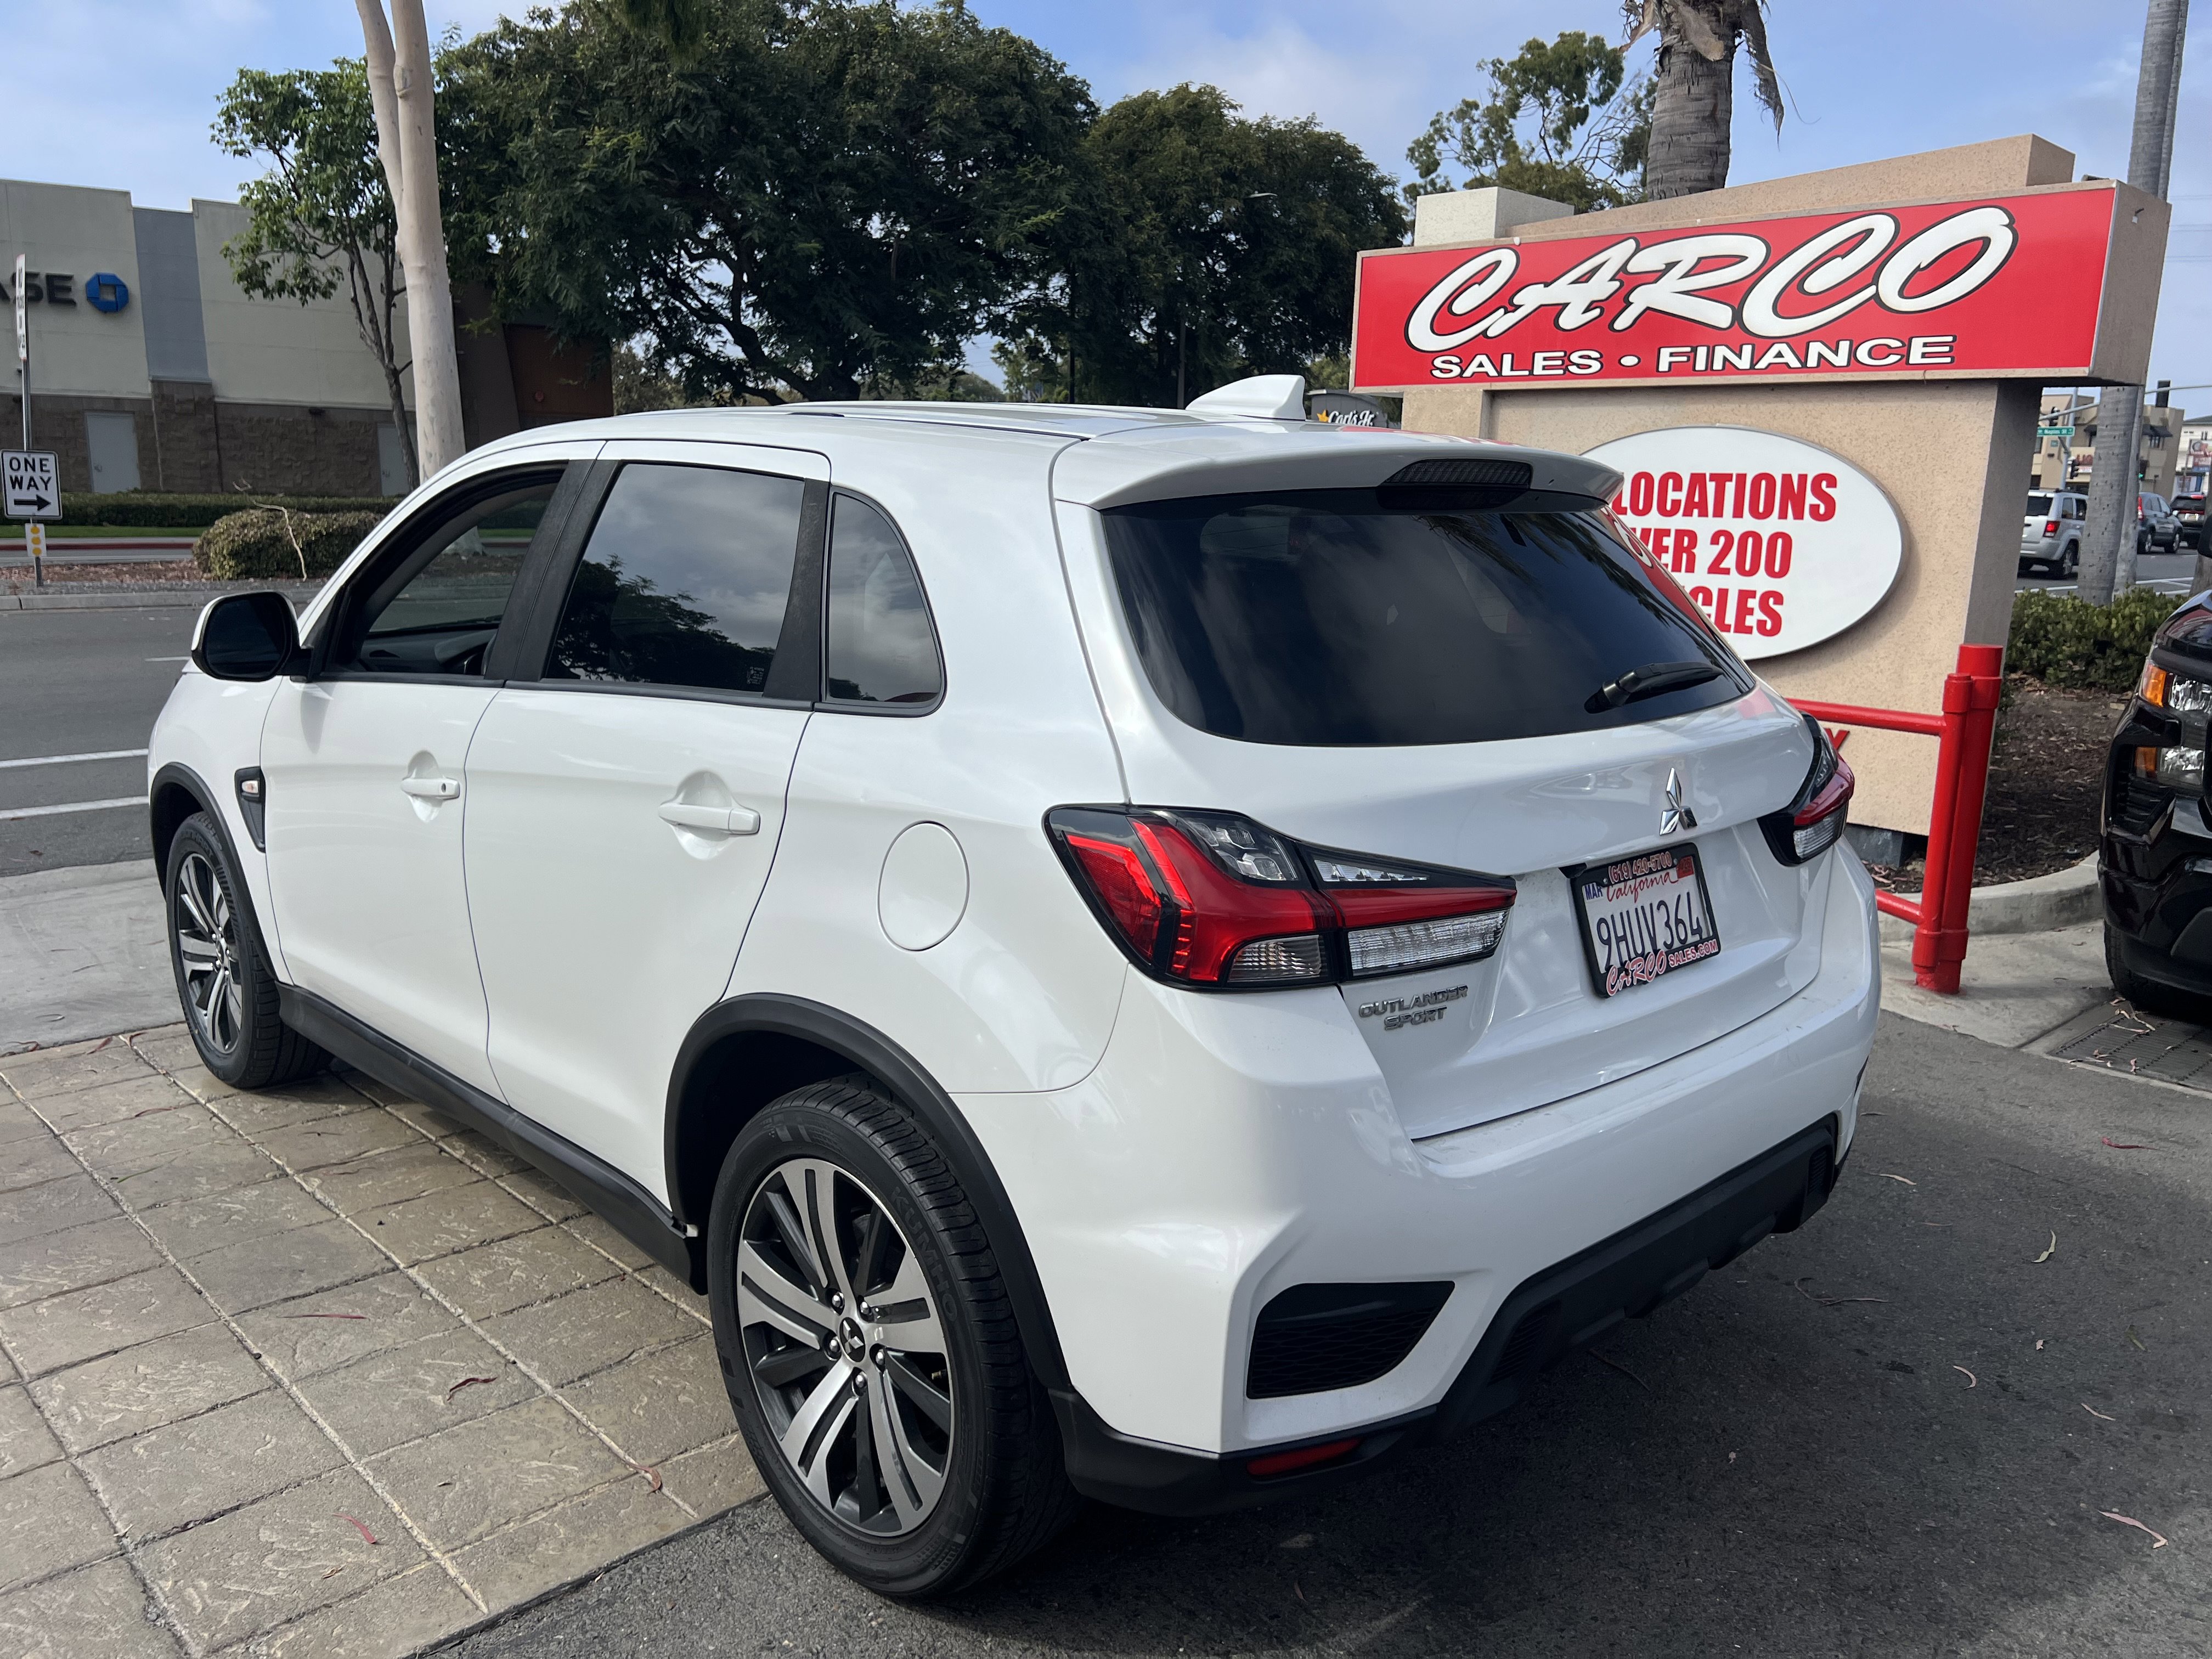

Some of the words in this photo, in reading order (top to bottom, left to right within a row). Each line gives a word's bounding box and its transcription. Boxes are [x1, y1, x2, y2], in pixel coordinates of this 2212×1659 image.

[1404, 206, 2019, 352] CARCO
[1431, 349, 1604, 379] SALES
[1656, 335, 1957, 372] FINANCE
[9, 456, 50, 472] ONE
[9, 475, 52, 491] WAY
[1707, 530, 1792, 578] 200
[1608, 861, 1632, 884] (619)
[1633, 851, 1672, 876] 420-5700
[1584, 884, 1603, 900] MAR
[1606, 872, 1679, 903] California
[1596, 891, 1702, 971] 9HUV364
[1606, 949, 1667, 996] CARCO
[1668, 939, 1718, 967] SALES.COM
[1359, 984, 1469, 1018] OUTLANDER
[1384, 1005, 1447, 1031] SPORT
